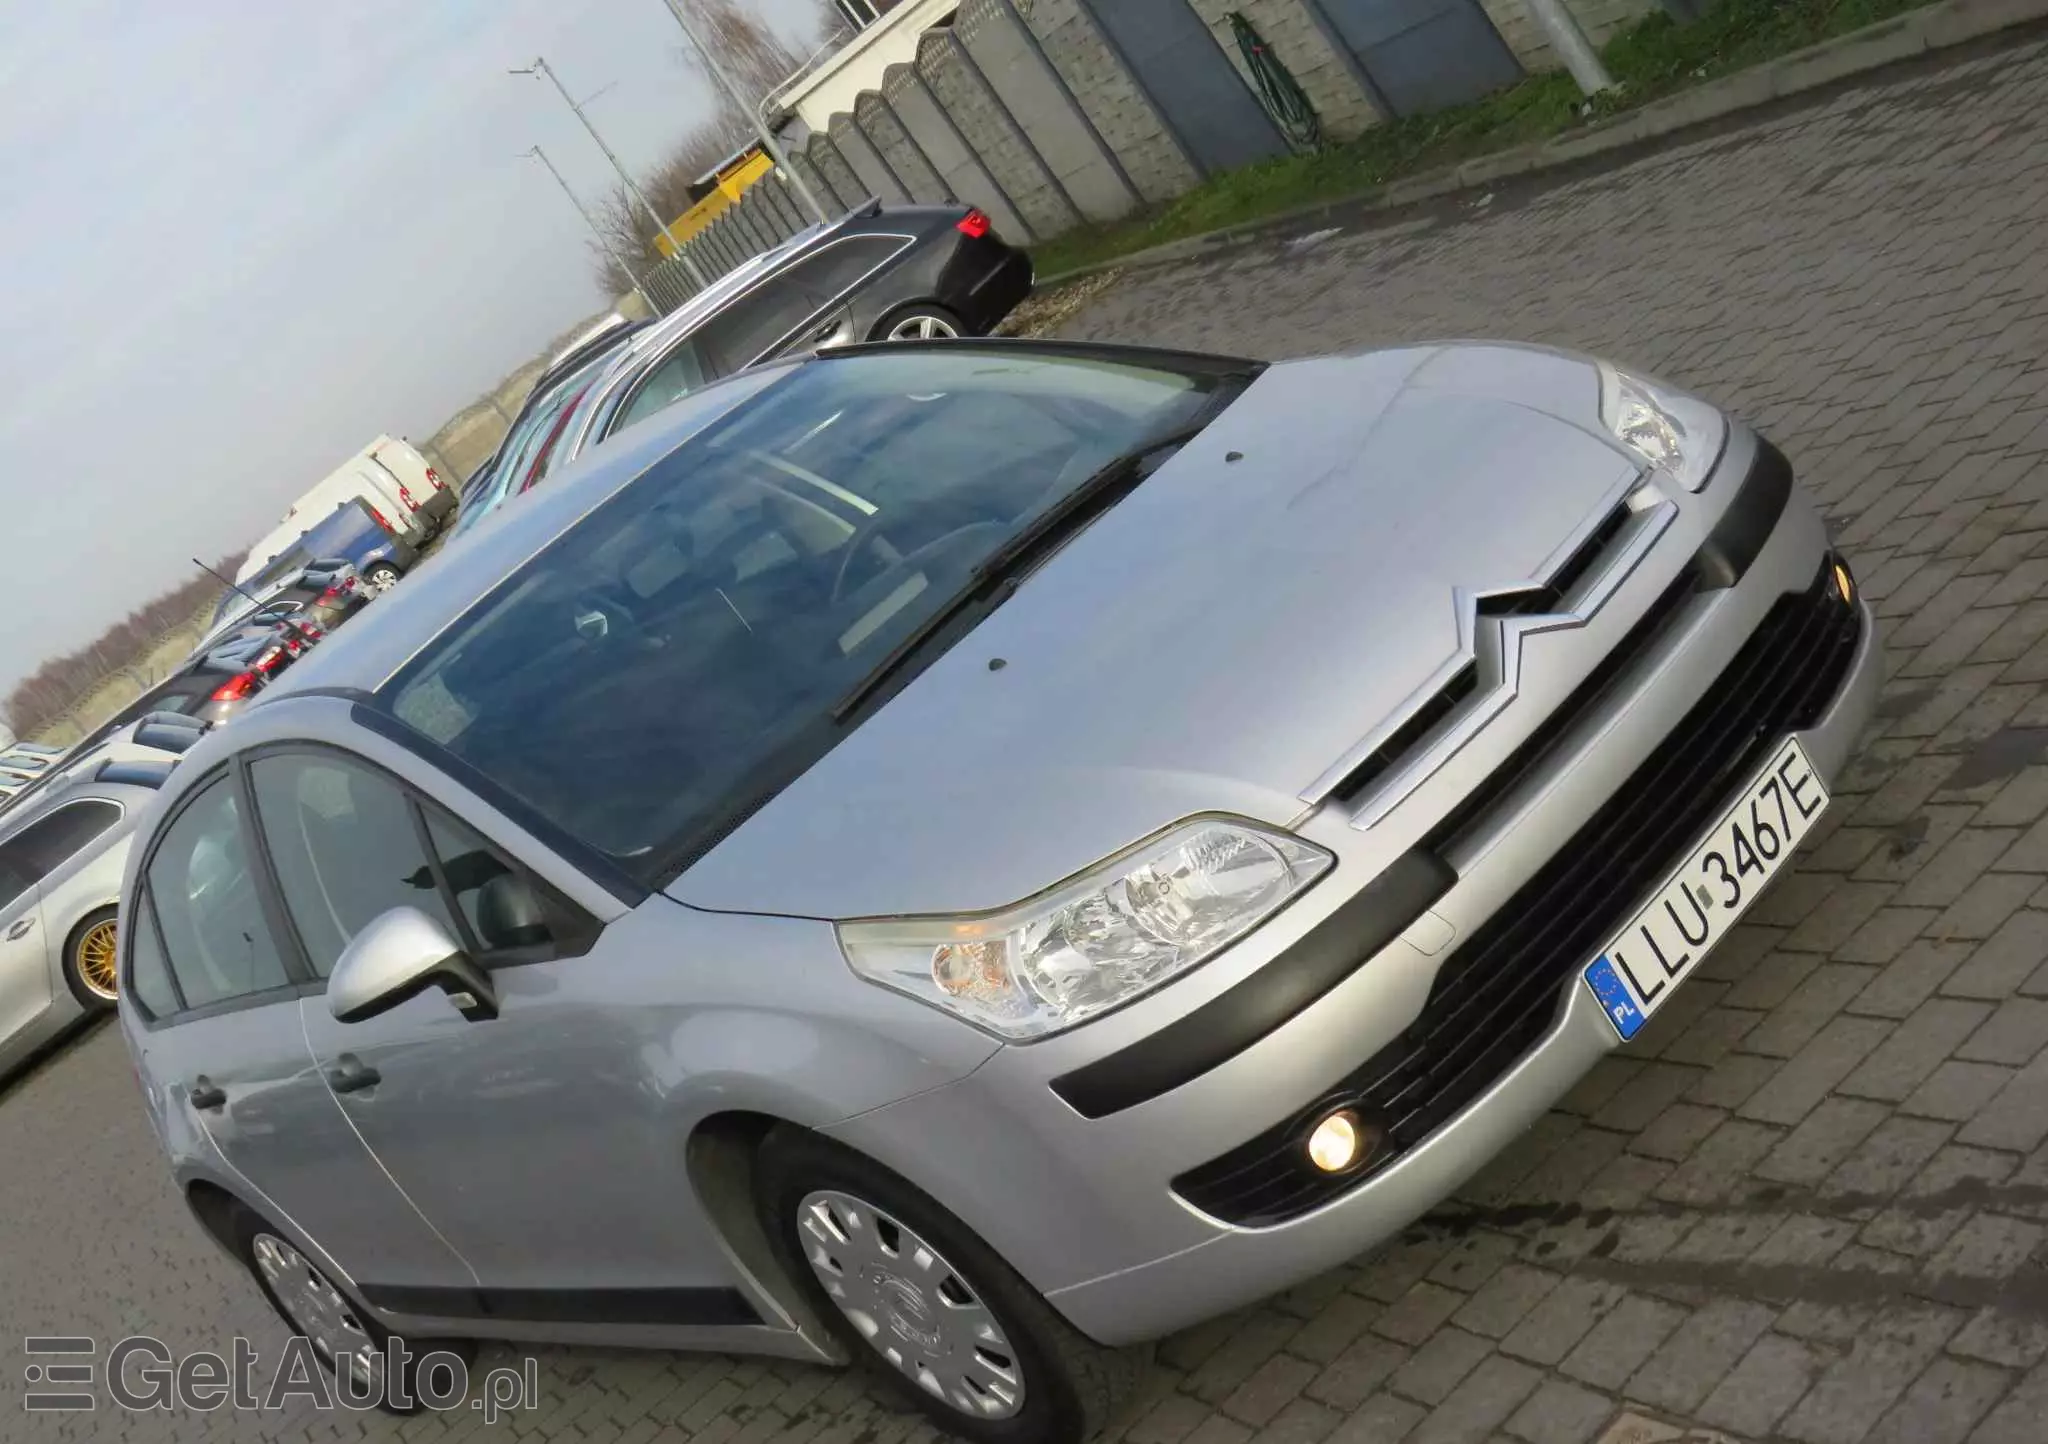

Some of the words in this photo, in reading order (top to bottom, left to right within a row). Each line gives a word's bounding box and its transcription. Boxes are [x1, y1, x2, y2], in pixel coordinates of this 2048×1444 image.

[1614, 882, 1709, 1005] LLU
[1702, 752, 1822, 908] 3467E
[1613, 1002, 1635, 1024] PL
